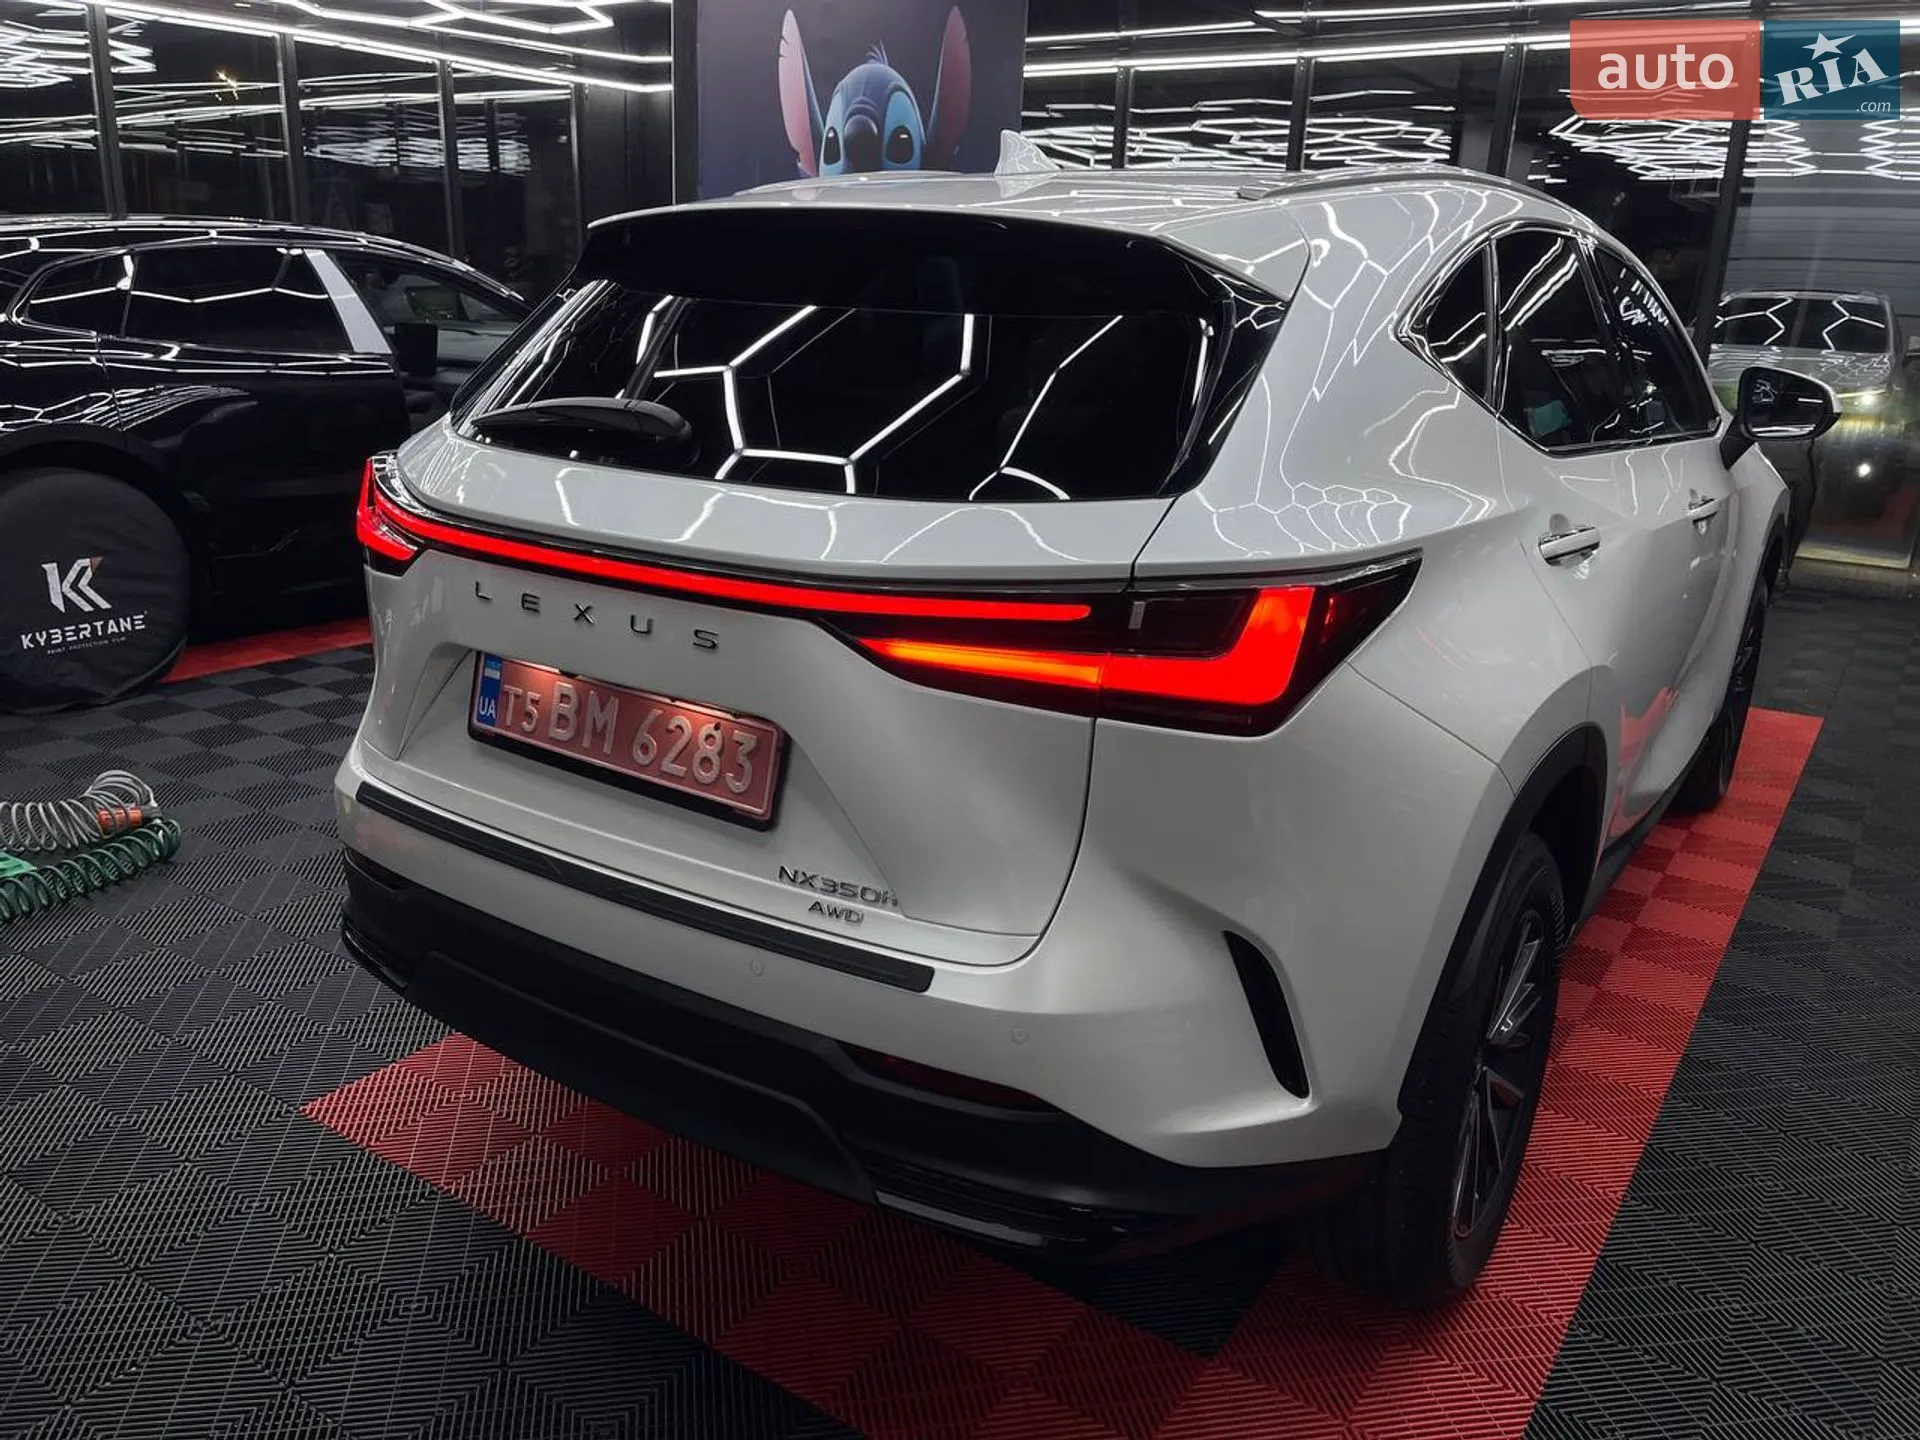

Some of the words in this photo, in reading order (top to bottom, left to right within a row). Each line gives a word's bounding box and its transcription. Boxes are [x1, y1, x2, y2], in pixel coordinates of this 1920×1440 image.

[20, 614, 146, 649] KYBERTANE
[475, 581, 719, 650] LEXUS
[478, 695, 496, 719] UA
[503, 685, 543, 733] T5
[549, 681, 619, 757] BM
[632, 709, 758, 795] 6283
[778, 865, 899, 907] NX350h
[808, 901, 864, 926] AWD
